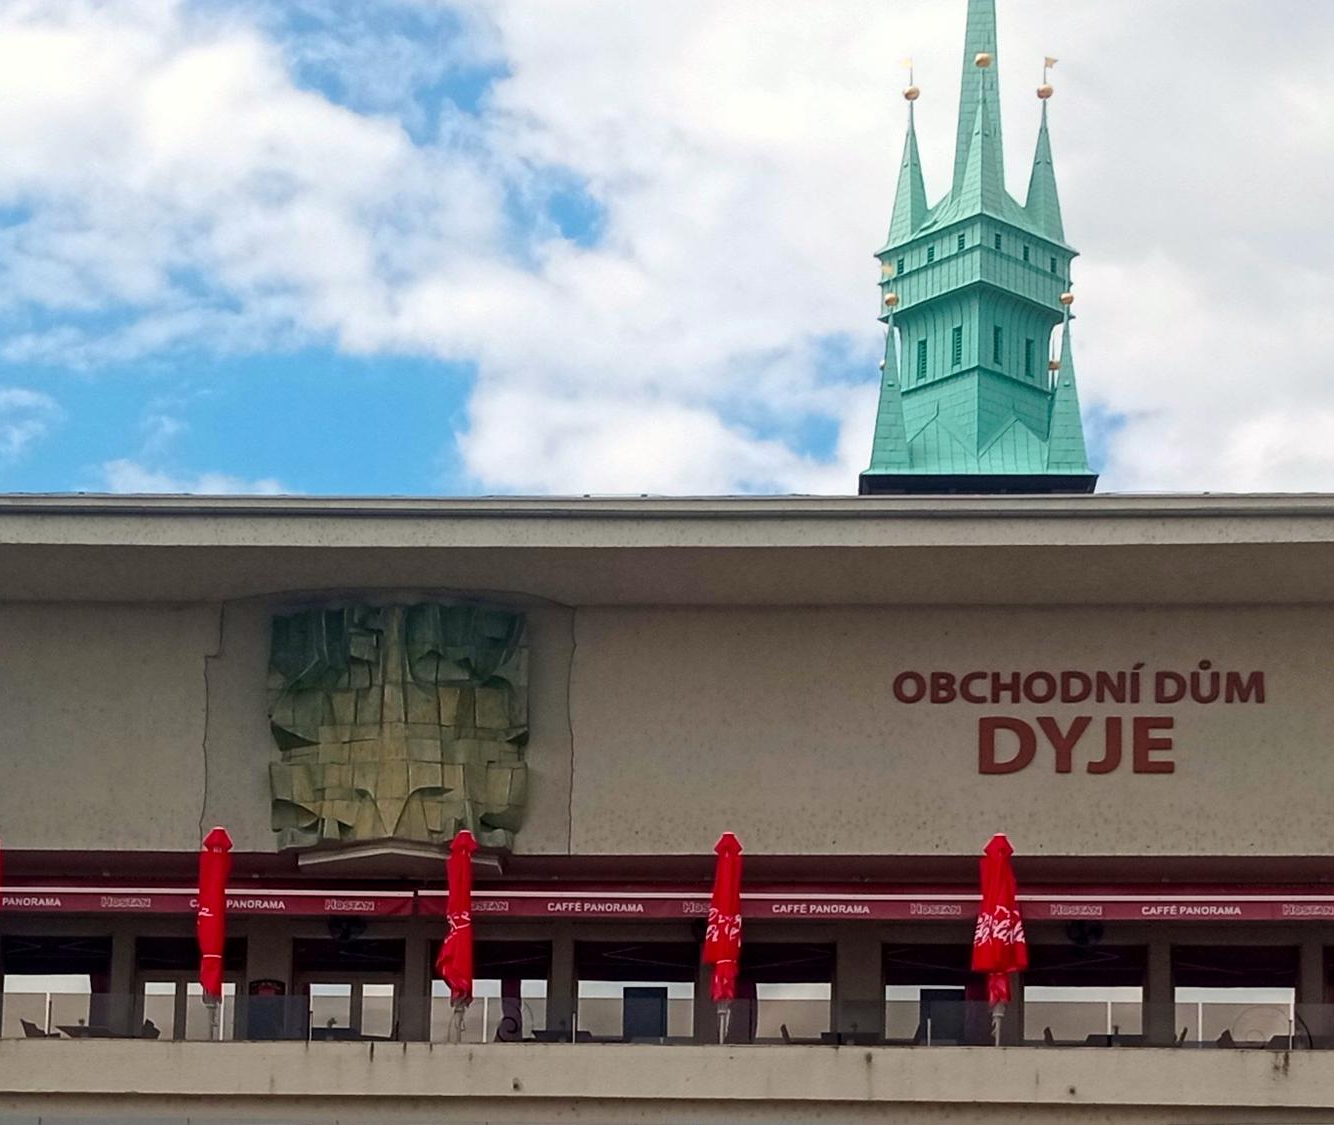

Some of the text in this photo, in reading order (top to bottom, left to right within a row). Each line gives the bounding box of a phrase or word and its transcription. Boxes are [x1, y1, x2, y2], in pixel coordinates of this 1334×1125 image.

[893, 660, 1266, 704] OBCHODNÍ DŮM
[978, 716, 1175, 774] DYJE
[2, 896, 62, 907] PANORAMA
[226, 899, 286, 910] PANORAMA
[584, 902, 644, 913] PANORAMA
[809, 903, 870, 915] PANORAMA
[1179, 905, 1242, 916] PANORAMA
